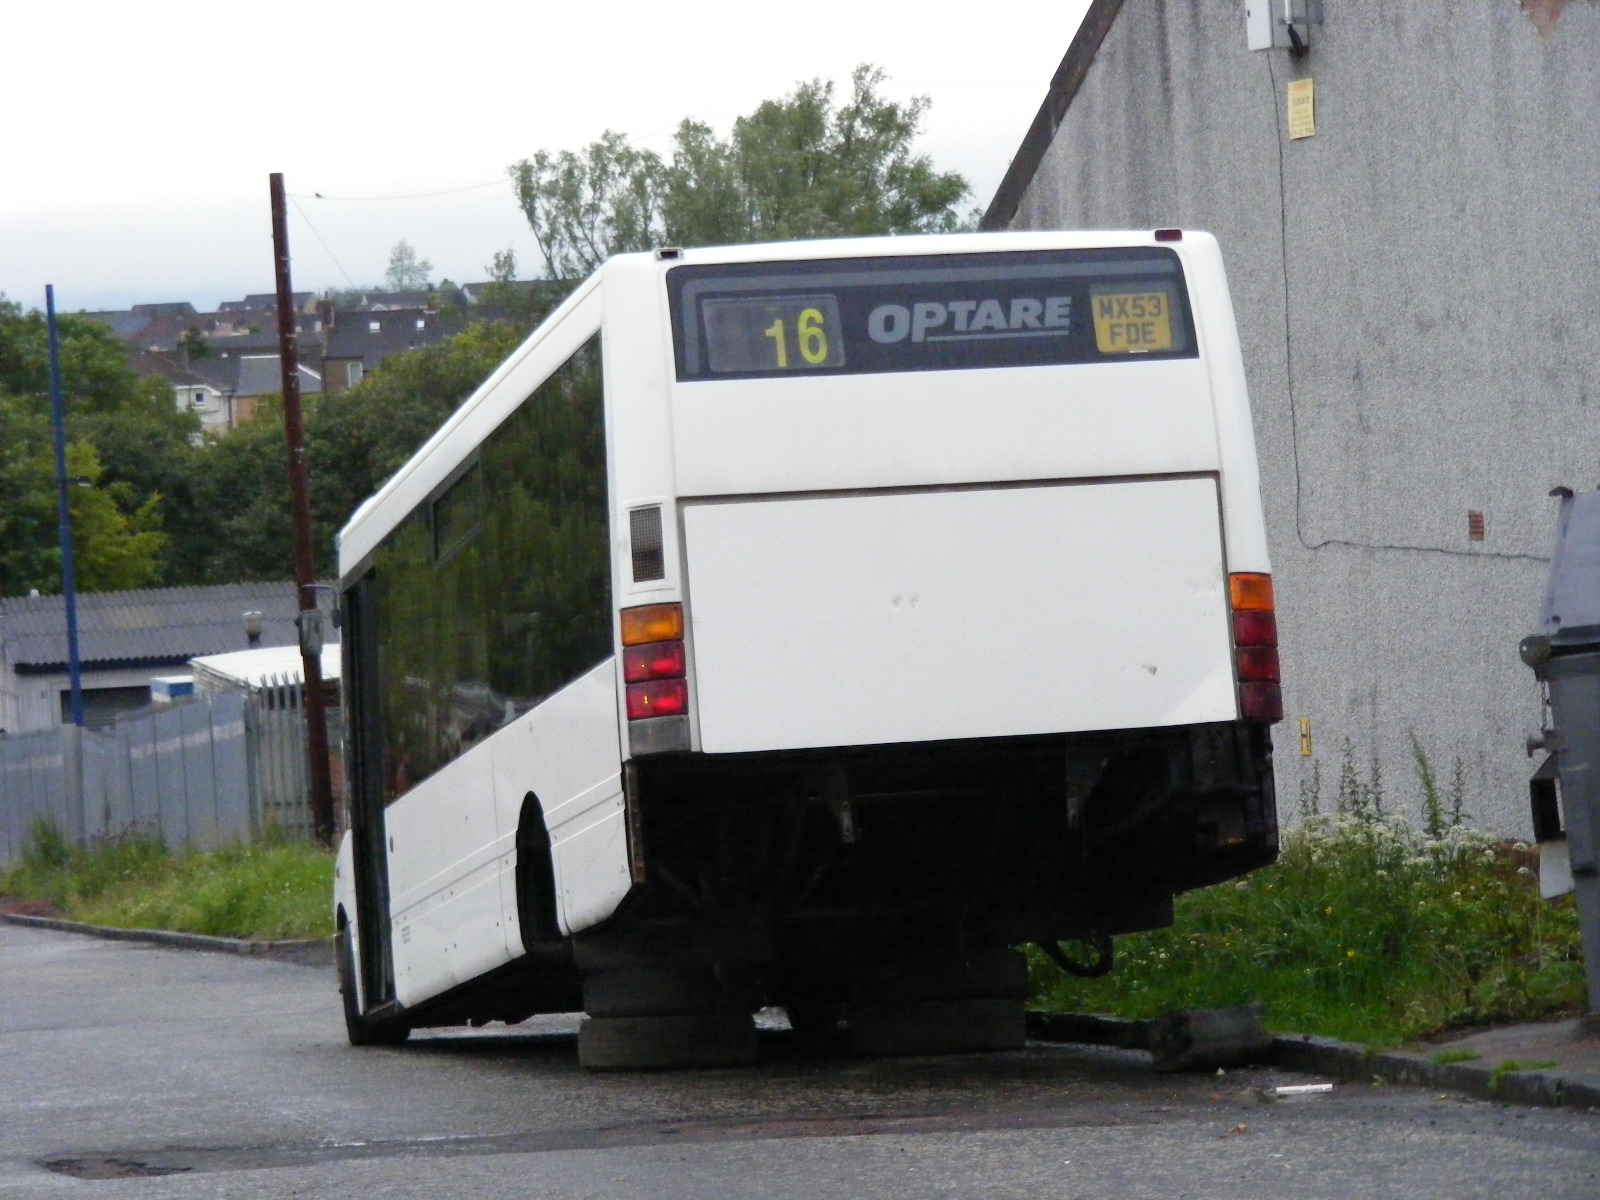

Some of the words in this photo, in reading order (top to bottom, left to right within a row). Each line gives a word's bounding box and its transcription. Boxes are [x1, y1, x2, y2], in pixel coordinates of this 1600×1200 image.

[868, 296, 1072, 344] OPTARE
[1098, 295, 1162, 320] MX53
[765, 308, 829, 368] 16
[1109, 322, 1157, 346] FDE
